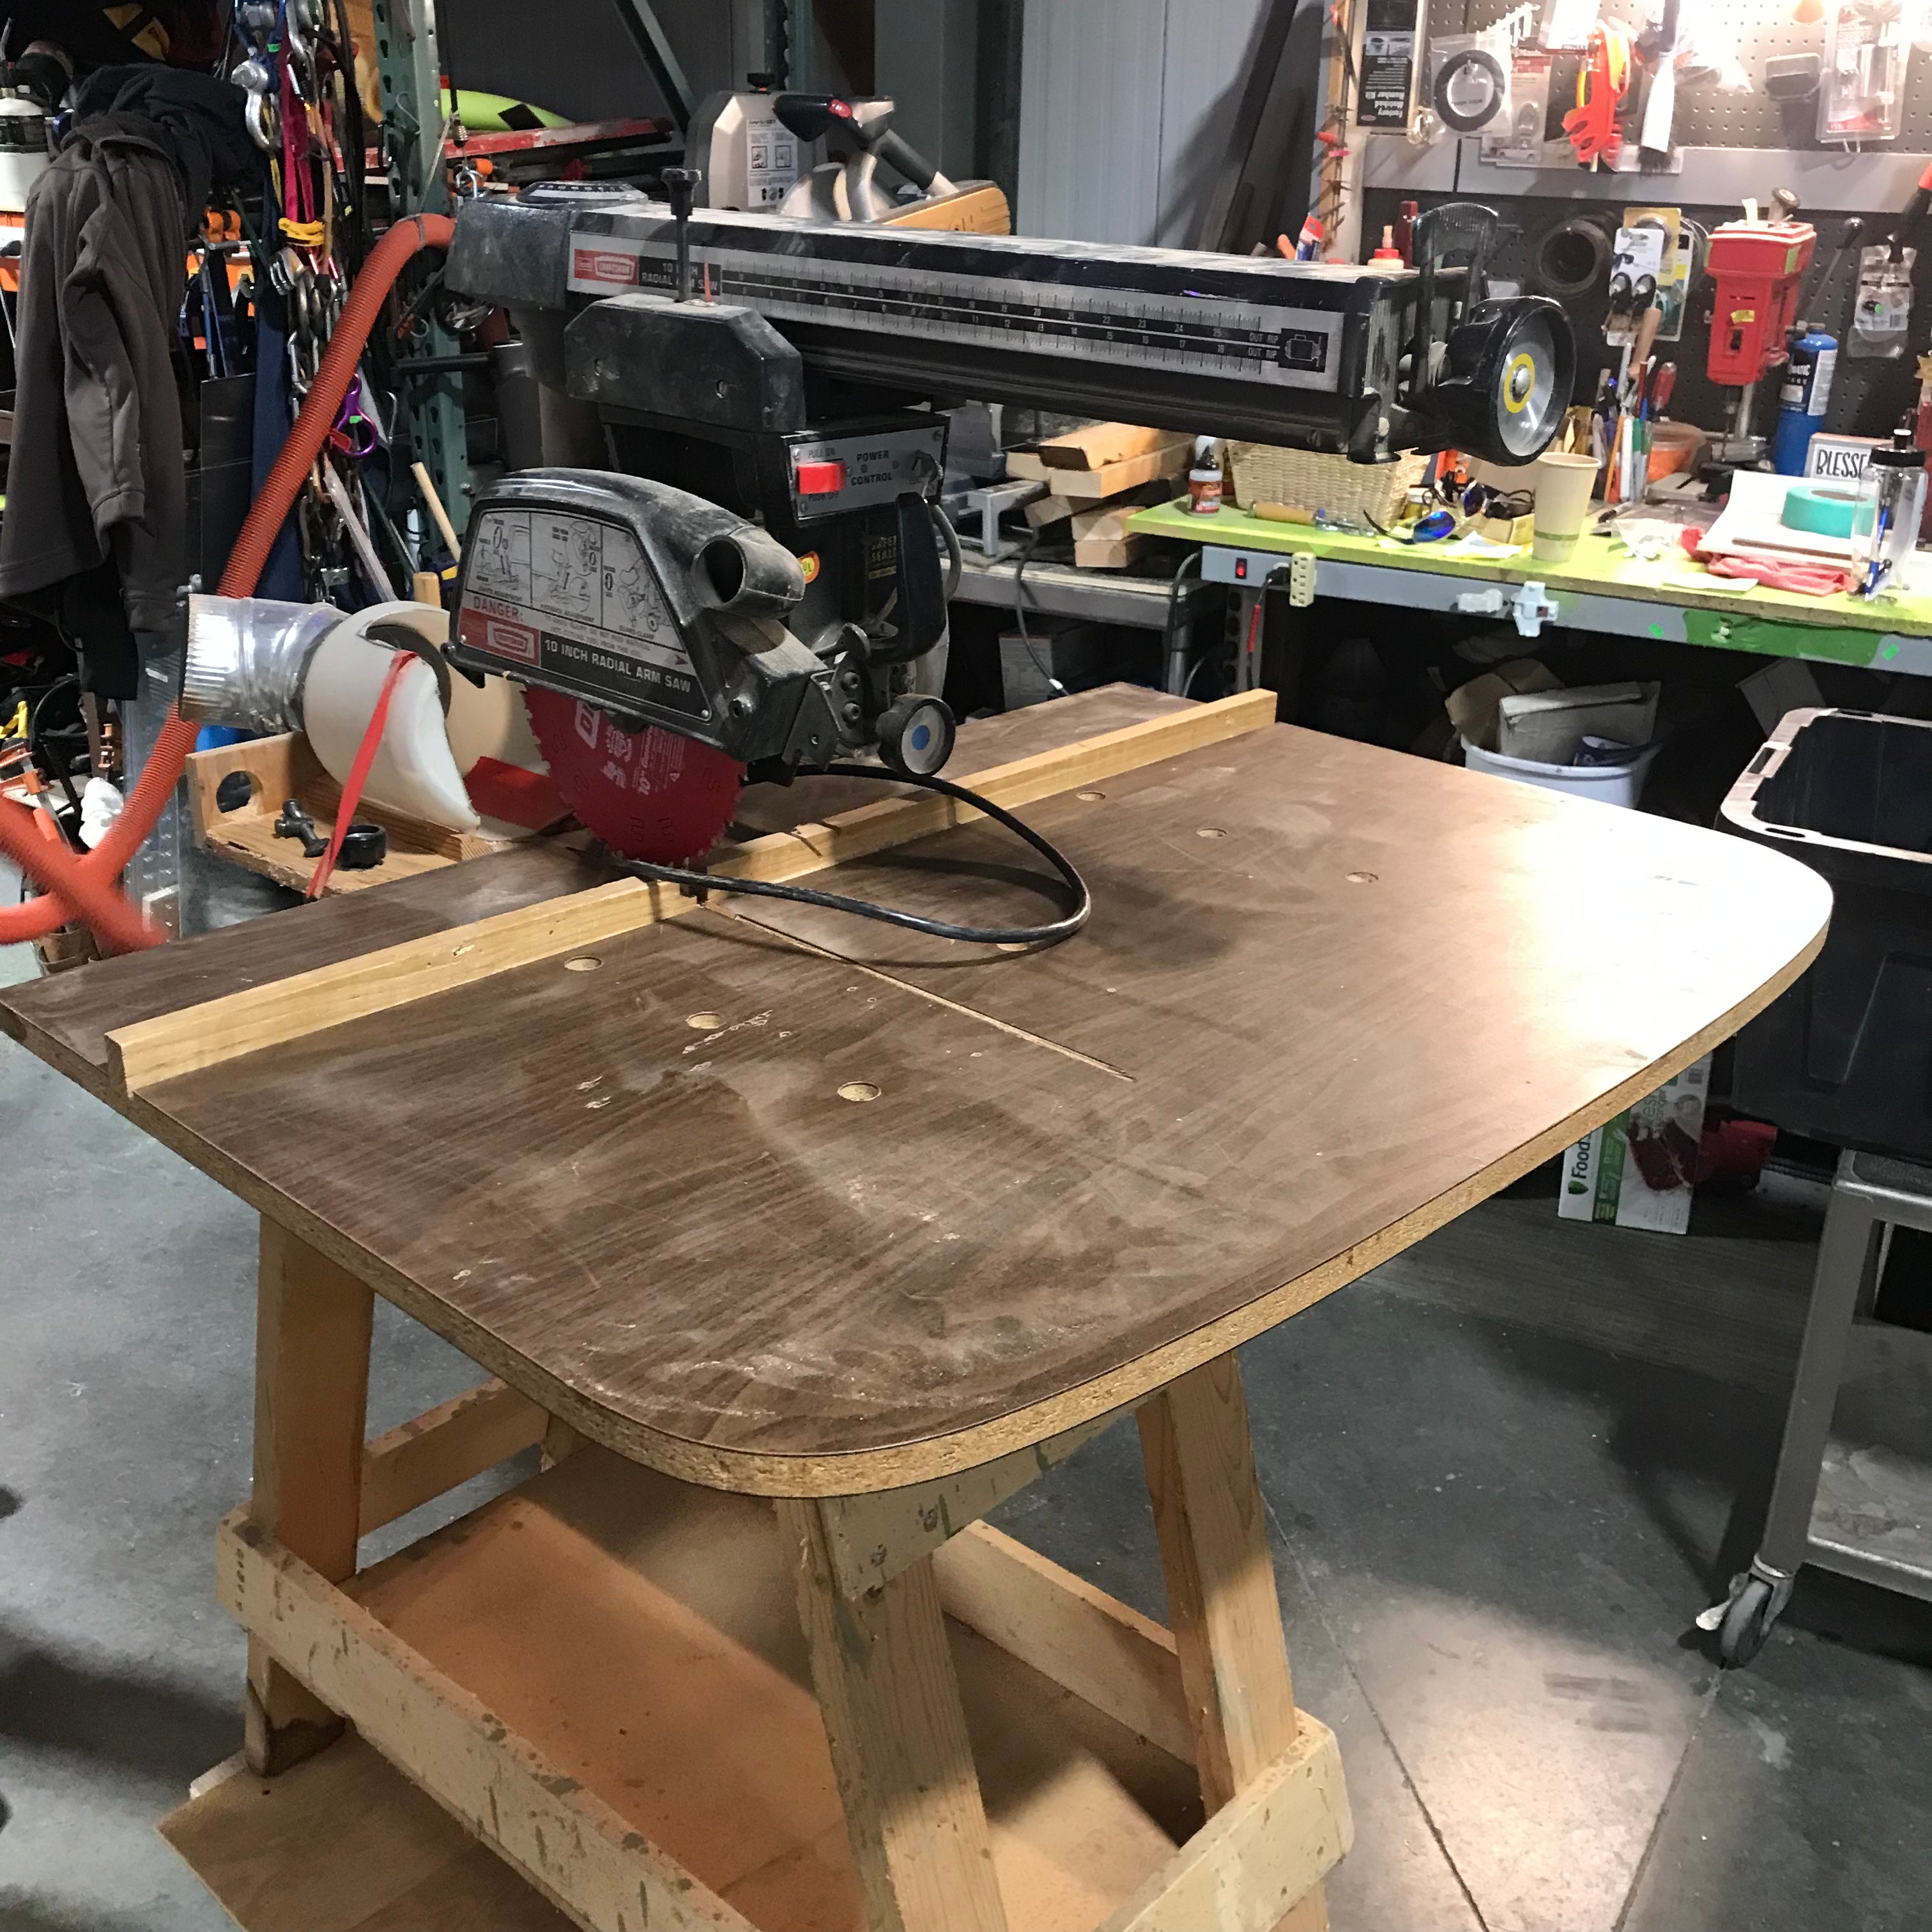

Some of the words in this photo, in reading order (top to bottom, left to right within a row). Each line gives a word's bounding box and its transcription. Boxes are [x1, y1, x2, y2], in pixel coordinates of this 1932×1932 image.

[641, 272, 673, 286] RADIAL
[698, 280, 719, 291] SW
[1102, 316, 1111, 325] 22
[1137, 319, 1146, 328] 23
[1174, 323, 1183, 332] 24
[1249, 332, 1263, 342] OUT
[1248, 347, 1262, 356] OUT
[808, 448, 824, 459] PULL
[856, 450, 889, 463] POWER
[850, 471, 893, 486] CONTROL
[544, 639, 558, 652] 10
[561, 643, 588, 662] INCH
[592, 653, 632, 675] RADIAL
[636, 666, 661, 684] ARM
[664, 675, 691, 693] SAW
